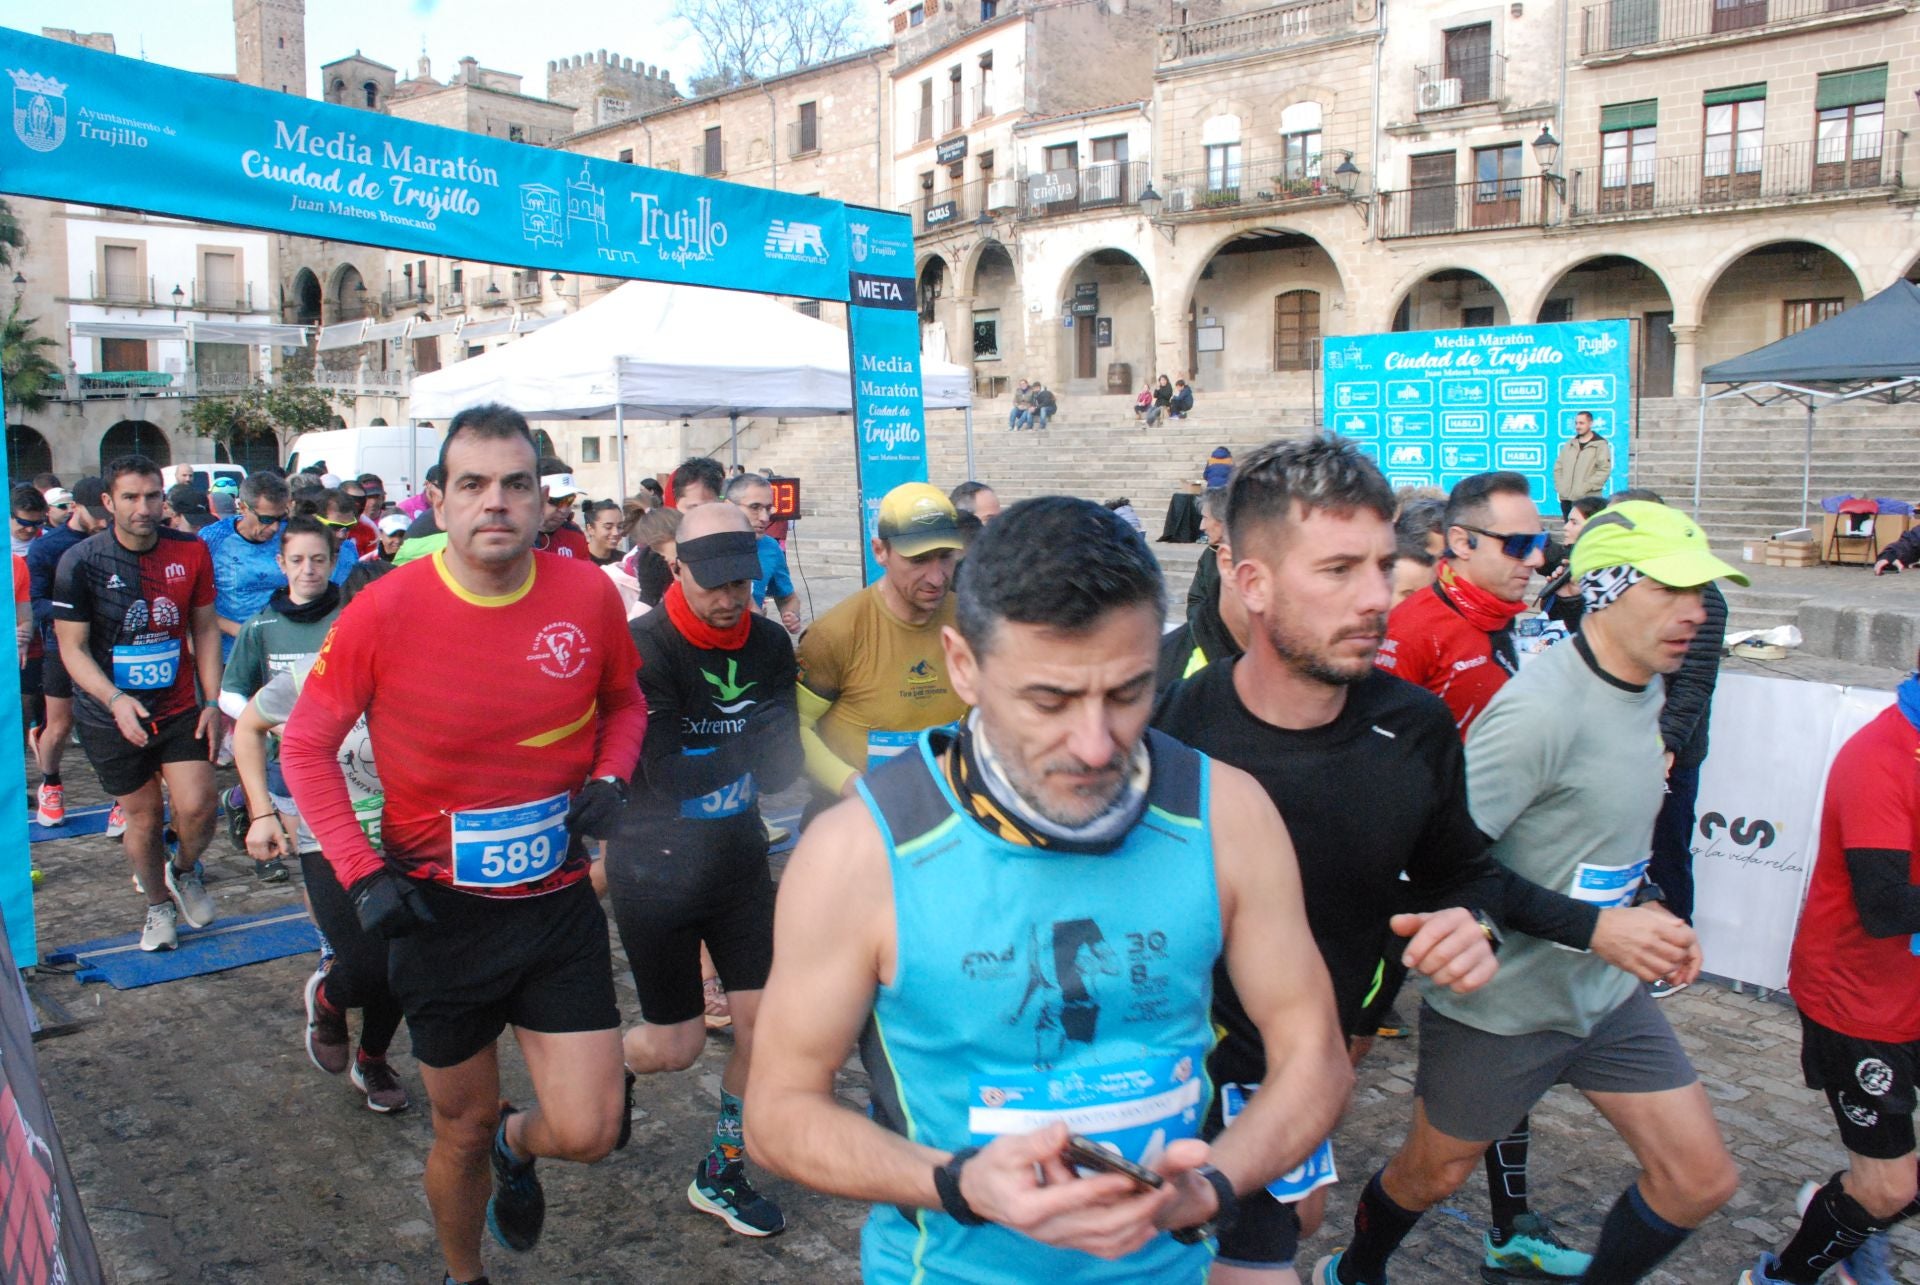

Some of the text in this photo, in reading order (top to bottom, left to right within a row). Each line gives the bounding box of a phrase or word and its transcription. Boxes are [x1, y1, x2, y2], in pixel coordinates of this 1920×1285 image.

[78, 106, 177, 137] Ayuntamiento de
[77, 121, 149, 148] Trujillo
[274, 120, 499, 187] Media Maratón
[241, 150, 481, 220] Ciudad de Trujillo
[1046, 173, 1059, 186] LA
[290, 195, 437, 231] Juan Mateos Broncano
[631, 192, 728, 256] Trujillo
[657, 243, 670, 261] te
[871, 244, 897, 257] Trujillo
[858, 280, 902, 301] META
[1434, 333, 1534, 348] Media Maratón
[1574, 332, 1618, 354] Trujillo
[862, 354, 914, 373] Media
[1385, 351, 1453, 371] Ciudad
[1455, 350, 1484, 367] de
[1488, 346, 1564, 372] Trujillo
[1425, 369, 1442, 378] Juan
[1443, 368, 1472, 377] Mateos
[861, 381, 919, 398] Maratón
[1507, 387, 1537, 395] HABLA
[869, 403, 911, 417] Ciudad de
[1450, 420, 1478, 428] HABLA
[863, 419, 921, 451] Trujillo
[1507, 452, 1536, 460] HABLA
[533, 632, 543, 651] CLUB
[128, 662, 173, 686] 539
[346, 771, 371, 794] SANTA
[481, 835, 550, 877] 589
